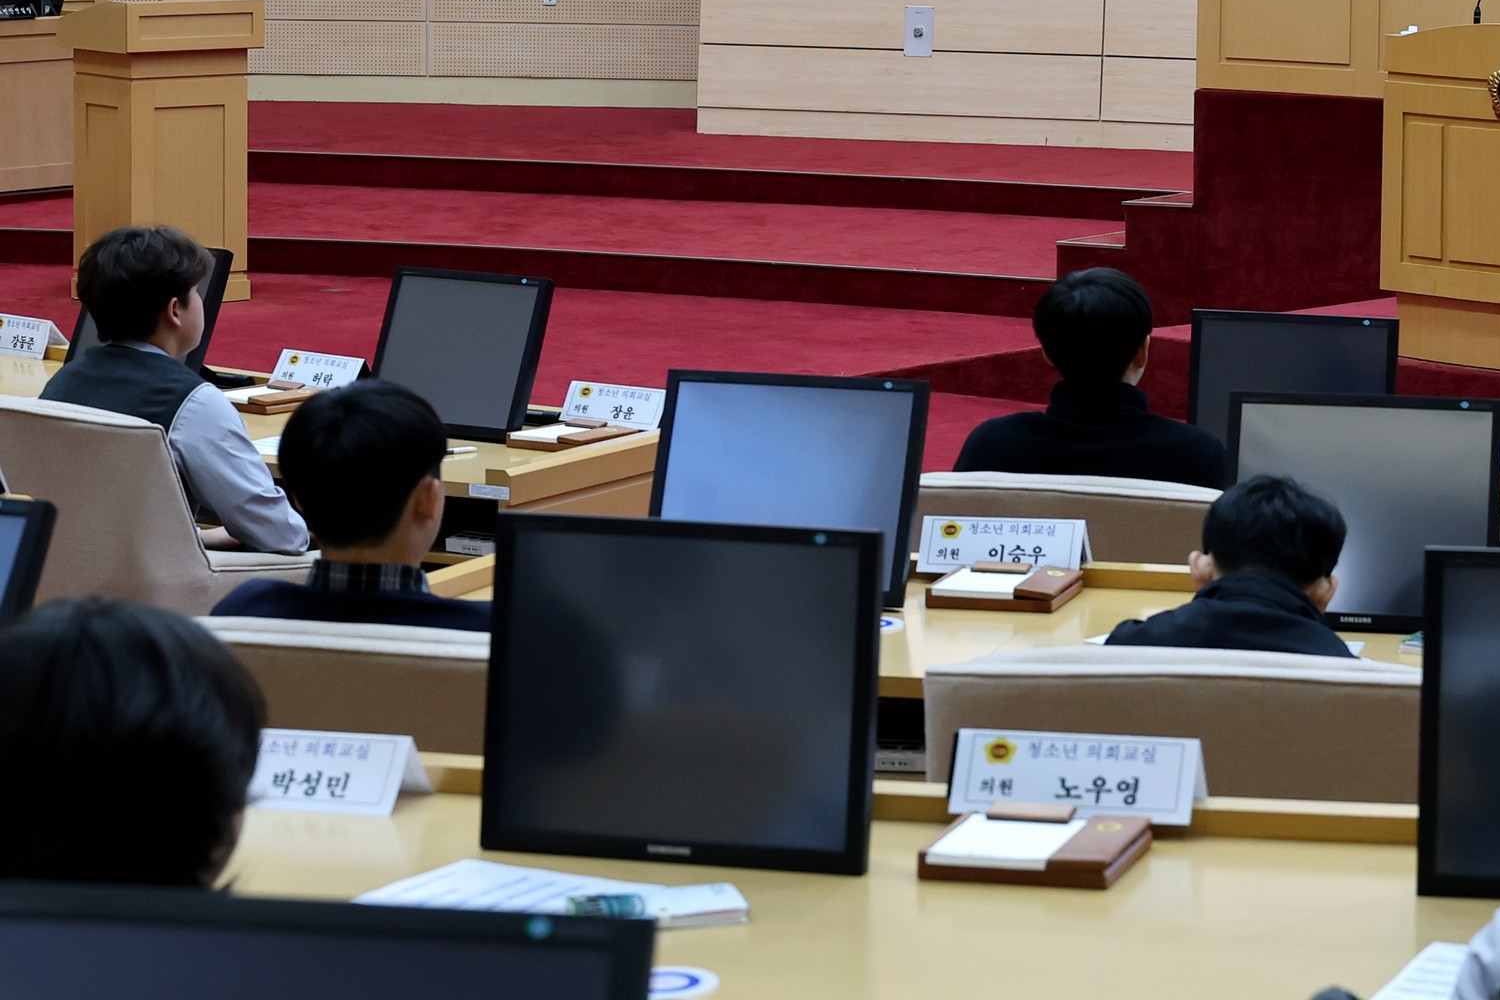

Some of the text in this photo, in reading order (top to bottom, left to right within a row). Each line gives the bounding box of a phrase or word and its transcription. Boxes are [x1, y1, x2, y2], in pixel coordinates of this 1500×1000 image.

[11, 334, 35, 350] 강동준
[303, 355, 350, 370] 청소년 의회교실
[281, 371, 295, 380] 의원
[597, 387, 652, 402] 청소년 의회교실
[573, 404, 635, 421] 의원 장윤
[969, 522, 1057, 537] 청소년 의회교실
[936, 544, 1047, 565] 의원 이승우
[259, 739, 371, 760] 소년 의회교실
[1027, 741, 1157, 764] 청소년 의회교실
[272, 769, 351, 798] 박성민
[978, 776, 1140, 806] 의원 노우영
